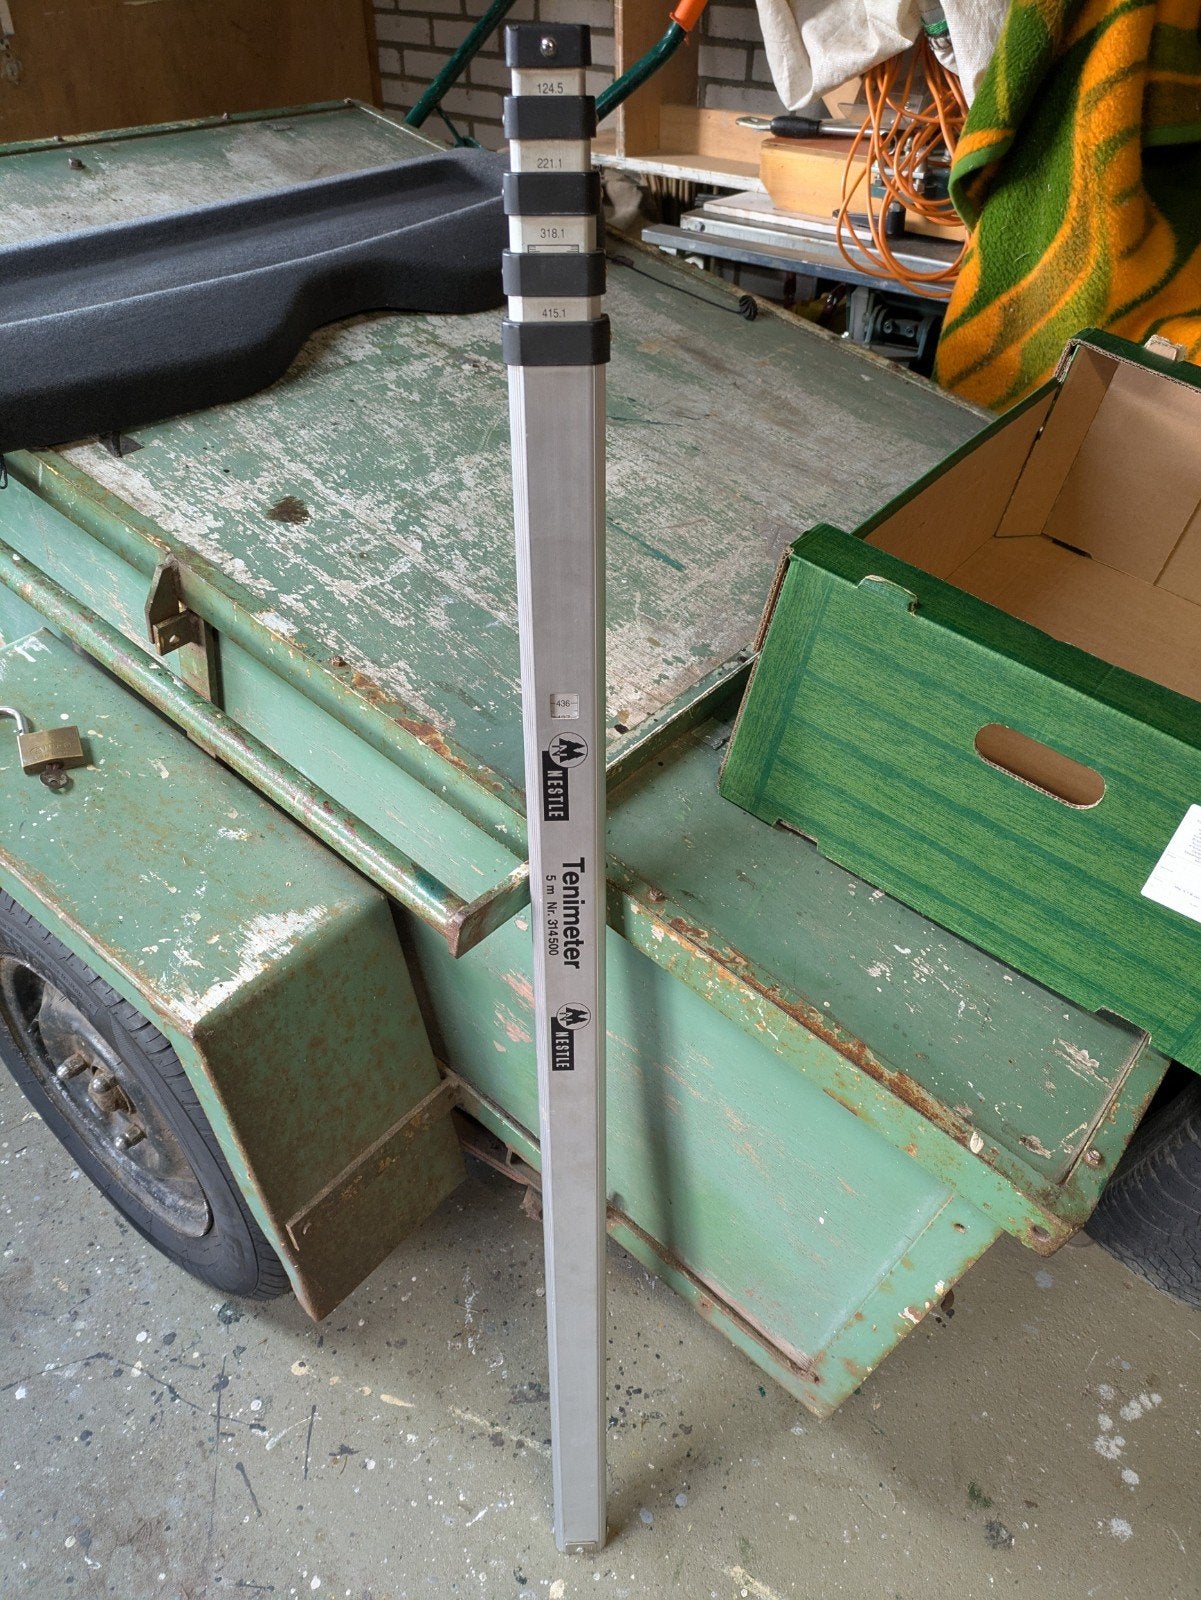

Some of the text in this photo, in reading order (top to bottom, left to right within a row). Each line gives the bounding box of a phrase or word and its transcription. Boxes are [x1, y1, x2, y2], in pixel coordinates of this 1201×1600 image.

[537, 82, 564, 95] 124.5
[537, 158, 563, 169] 221.1
[540, 228, 565, 239] 318.1
[542, 308, 567, 318] 415.1
[555, 699, 571, 708] 436
[547, 770, 564, 817] NESTLE
[546, 885, 554, 895] m
[547, 902, 557, 916] Nr.
[562, 857, 586, 970] Tenimeter
[547, 919, 559, 956] 314500
[555, 1031, 570, 1068] NESTLE
